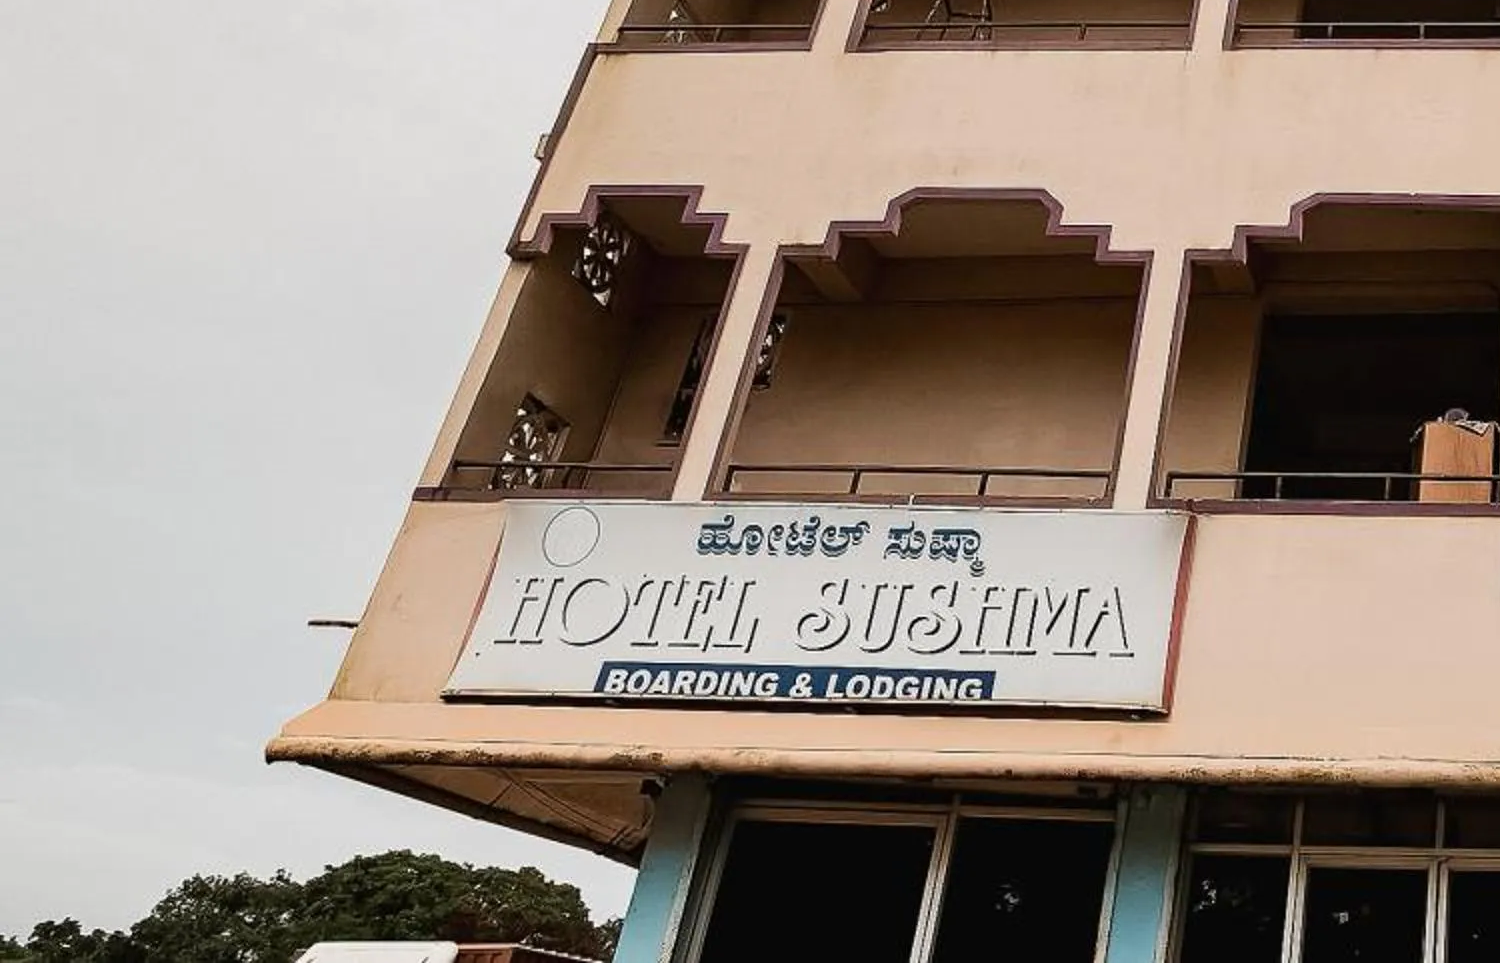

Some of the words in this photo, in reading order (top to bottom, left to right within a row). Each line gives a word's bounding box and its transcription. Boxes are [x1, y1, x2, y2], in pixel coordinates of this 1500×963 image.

[696, 514, 870, 557] ಹೋಟೆಲ್
[493, 575, 760, 653] HOTEL
[796, 577, 1135, 658] SUSHMA
[602, 669, 778, 697] BOARDING
[788, 673, 813, 699] &
[826, 674, 983, 701] LODGING
